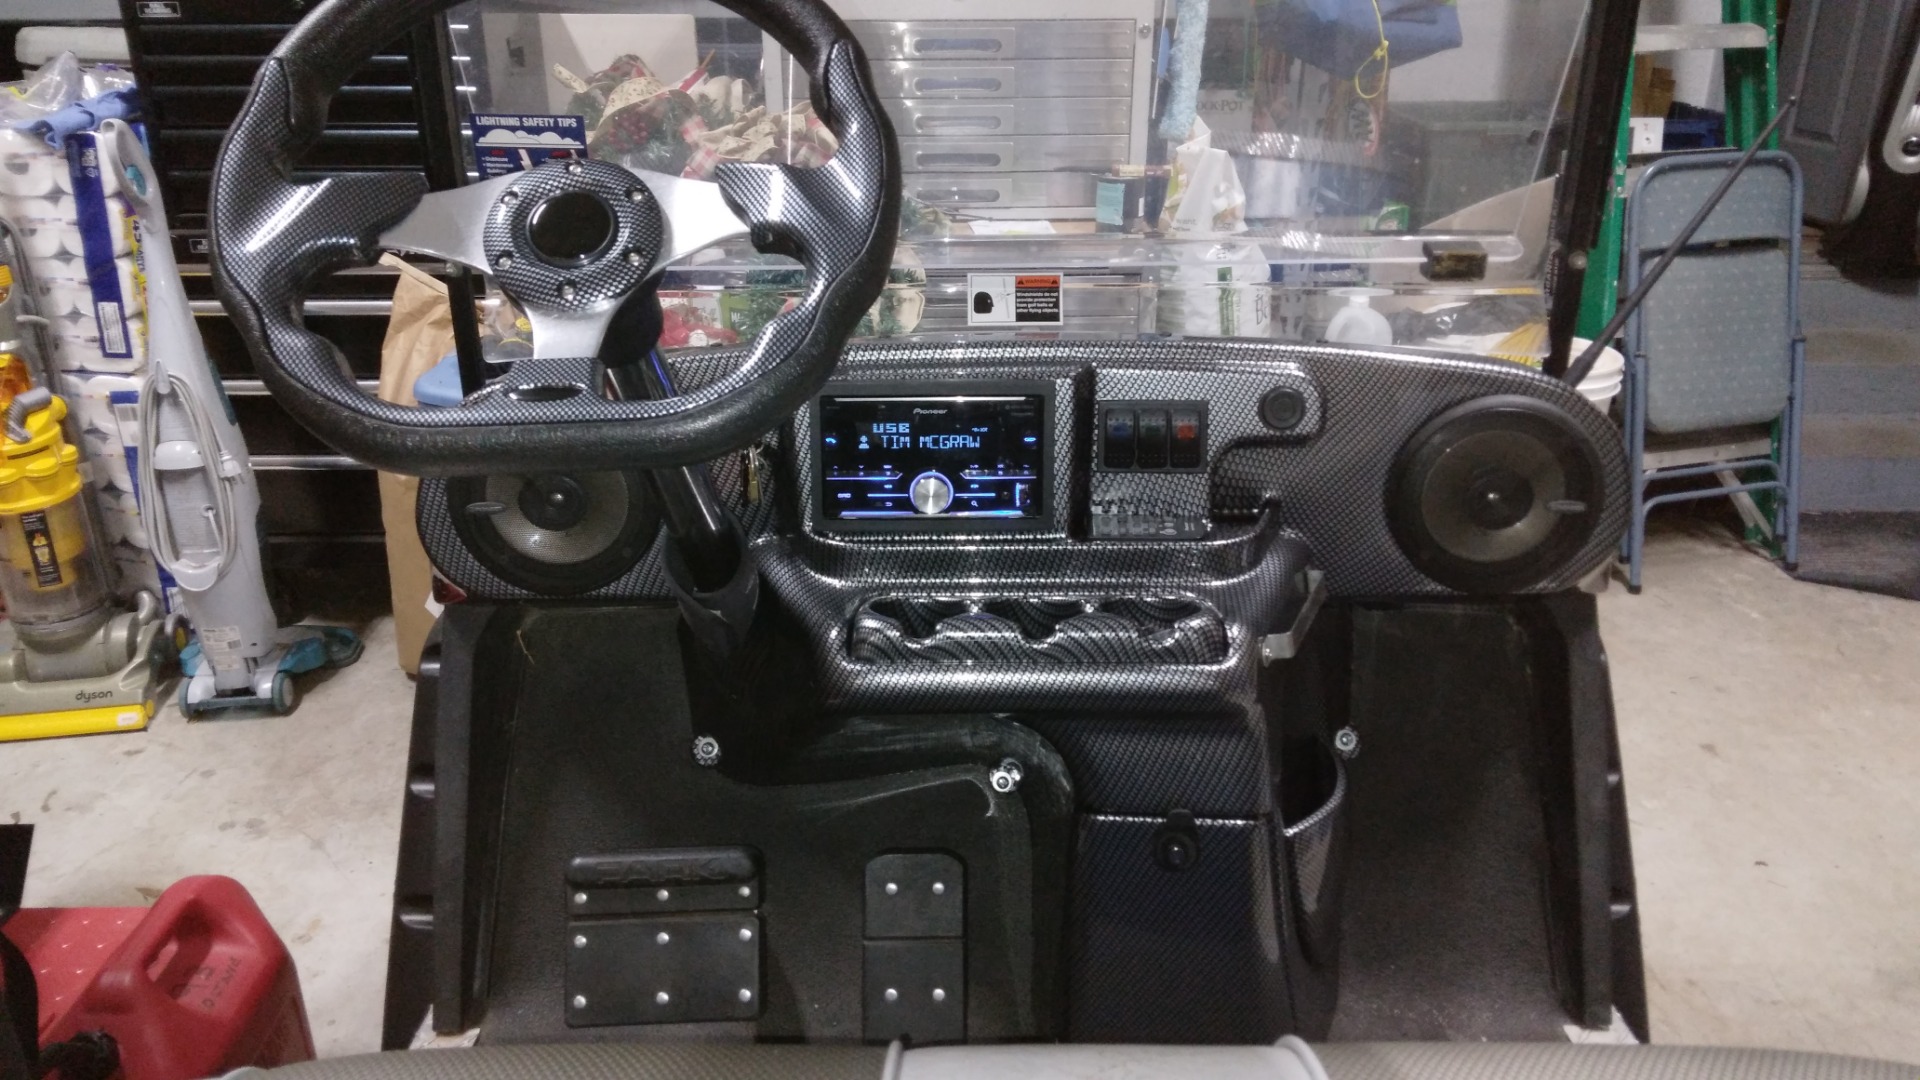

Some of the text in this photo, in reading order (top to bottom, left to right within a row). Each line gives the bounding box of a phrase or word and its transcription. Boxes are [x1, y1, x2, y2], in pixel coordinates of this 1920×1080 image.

[475, 116, 577, 127] LIGHTNING SAFETY TIPS
[873, 423, 909, 433] USB
[881, 435, 980, 449] TIM MCGRAW
[75, 690, 113, 703] dyson
